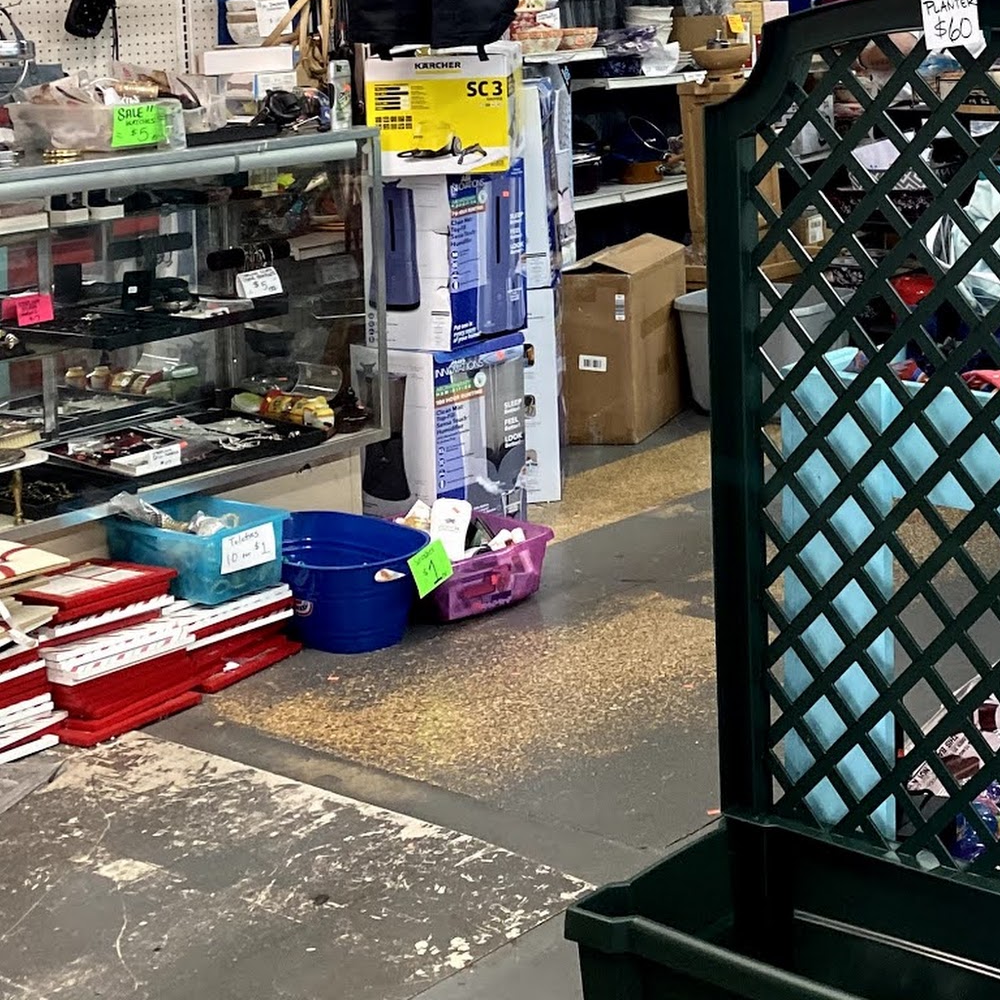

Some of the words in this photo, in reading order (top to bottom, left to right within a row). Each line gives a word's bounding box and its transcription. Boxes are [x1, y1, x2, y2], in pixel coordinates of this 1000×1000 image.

[934, 16, 973, 43] $60
[466, 81, 489, 97] SC
[492, 81, 503, 97] 3
[504, 431, 523, 442] LOOK
